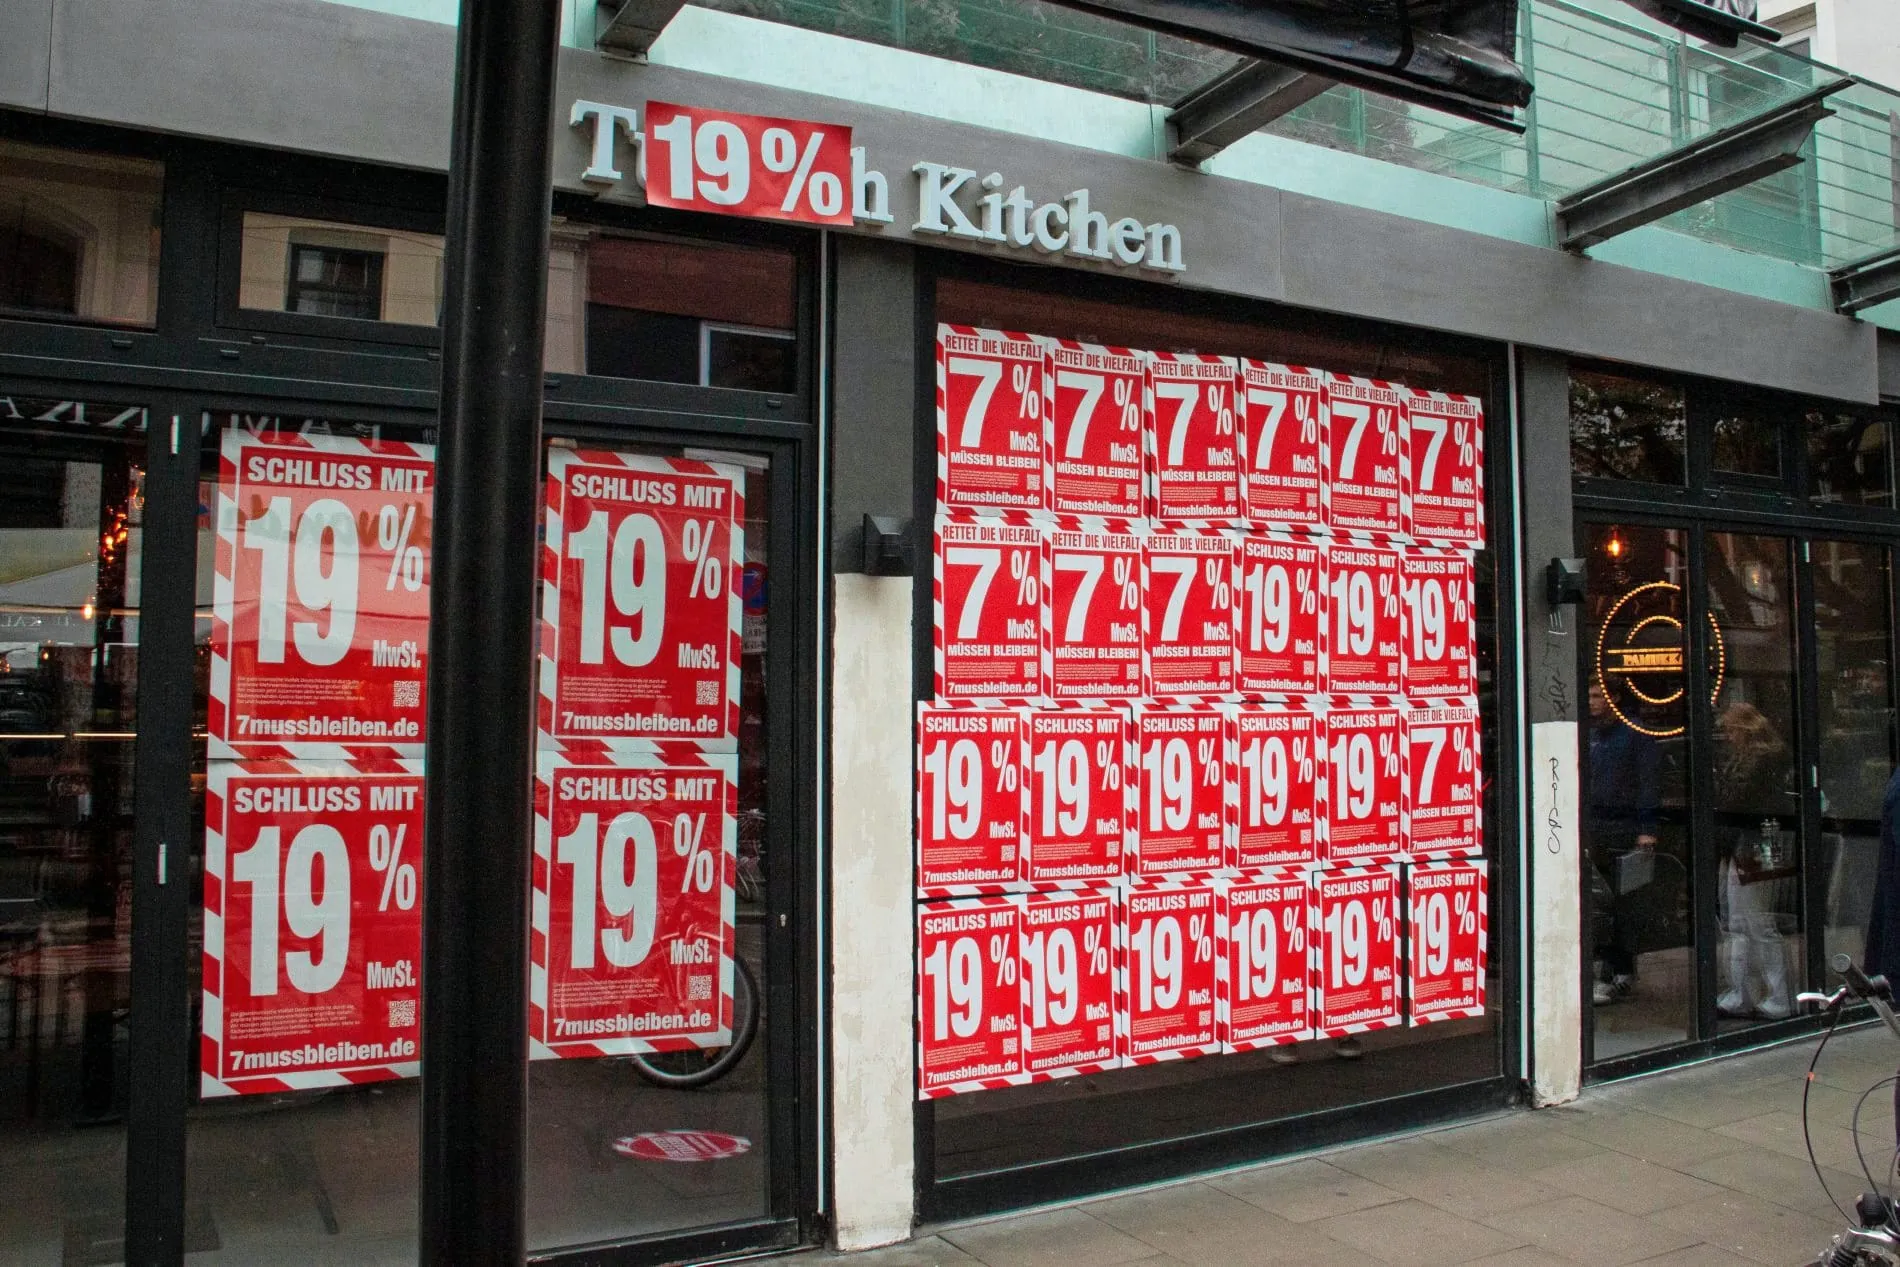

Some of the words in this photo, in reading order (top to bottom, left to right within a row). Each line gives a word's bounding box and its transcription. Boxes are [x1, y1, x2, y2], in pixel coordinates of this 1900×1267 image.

[912, 160, 1187, 273] Kitchen
[946, 335, 978, 351] RETTET
[982, 340, 997, 353] DIE
[1001, 342, 1042, 358] VIELFALT
[1053, 350, 1083, 366] RETTET
[1086, 354, 1100, 368] DIE
[1103, 356, 1142, 372] VIELFALT
[1151, 363, 1178, 377] RETTET
[1181, 364, 1193, 376] DIE
[1196, 365, 1232, 378] VIELFALT
[1010, 431, 1040, 452] MwSt.
[951, 450, 993, 465] MÜSSEN
[996, 456, 1040, 468] BLEIBEN!
[1111, 443, 1138, 463] MwSt.
[248, 456, 371, 491] SCHLUSS
[380, 468, 428, 494] MIT
[1057, 461, 1094, 476] MÜSSEN
[1098, 466, 1138, 479] BLEIBEN!
[1162, 469, 1194, 481] MÜSSEN
[1198, 472, 1235, 481] BLEIBEN!
[572, 474, 676, 505] SCHLUSS
[684, 485, 725, 508] MIT
[951, 489, 1040, 505] 7mussbleiben.de
[1057, 498, 1138, 514] 7mussbleiben.de
[1163, 505, 1237, 515] 7mussbleiben.de
[1250, 506, 1317, 520] 7mussbleiben.de
[1333, 514, 1397, 529] 7mussbleiben.de
[943, 525, 976, 540] RETTET
[981, 527, 995, 540] DIE
[999, 528, 1040, 542] VIELFALT
[1414, 525, 1474, 538] 7mussbleiben.de
[1052, 533, 1082, 547] RETTET
[1086, 534, 1098, 548] DIE
[1102, 536, 1140, 550] VIELFALT
[1147, 536, 1176, 550] RETTET
[1180, 538, 1192, 550] DIE
[1196, 538, 1231, 551] VIELFALT
[1247, 543, 1294, 560] SCHLUSS
[1297, 549, 1316, 562] MIT
[1332, 550, 1376, 566] SCHLUSS
[1379, 555, 1396, 568] MIT
[1404, 560, 1445, 573] SCHLUSS
[1448, 562, 1464, 573] MIT
[1008, 619, 1037, 639] MwSt.
[1111, 623, 1138, 642] MwSt.
[372, 639, 420, 668] MwSt.
[678, 643, 719, 669] MwSt.
[948, 642, 990, 656] MÜSSEN
[994, 645, 1037, 656] BLEIBEN!
[1056, 645, 1095, 658] MÜSSEN
[1098, 648, 1138, 658] BLEIBEN!
[1153, 644, 1189, 657] MÜSSEN
[1192, 646, 1230, 656] BLEIBEN!
[948, 682, 1037, 694] 7mussbleiben.de
[1056, 683, 1138, 694] 7mussbleiben.de
[1154, 680, 1230, 692] 7mussbleiben.de
[1243, 678, 1314, 690] 7mussbleiben.de
[1331, 680, 1398, 691] 7mussbleiben.de
[1409, 684, 1468, 695] 7mussbleiben.de
[236, 715, 418, 736] 7mussbleiben.de
[562, 712, 717, 732] 7mussbleiben.de
[926, 717, 987, 732] SCHLUSS
[992, 718, 1016, 732] MIT
[1035, 718, 1093, 733] SCHLUSS
[1097, 719, 1119, 732] MIT
[1144, 718, 1195, 732] SCHLUSS
[1199, 718, 1220, 731] MIT
[1242, 718, 1289, 731] SCHLUSS
[1292, 717, 1311, 730] MIT
[1330, 714, 1376, 728] SCHLUSS
[1379, 714, 1396, 726] MIT
[560, 777, 667, 800] SCHLUSS
[674, 778, 716, 800] MIT
[235, 787, 360, 812] SCHLUSS
[370, 786, 418, 810] MIT
[990, 822, 1016, 838] MwSt.
[1097, 818, 1120, 834] MwSt.
[1332, 841, 1398, 856] 7mussbleiben.de
[1412, 836, 1473, 850] 7mussbleiben.de
[1142, 856, 1220, 870] 7mussbleiben.de
[1242, 849, 1311, 864] 7mussbleiben.de
[924, 868, 1014, 882] 7mussbleiben.de
[1034, 863, 1118, 877] 7mussbleiben.de
[1324, 880, 1369, 898] SCHLUSS
[1372, 878, 1390, 891] MIT
[1414, 874, 1452, 890] SCHLUSS
[1455, 873, 1475, 885] MIT
[1132, 895, 1186, 912] SCHLUSS
[1190, 893, 1210, 908] MIT
[1231, 888, 1280, 905] SCHLUSS
[1284, 886, 1303, 900] MIT
[1084, 903, 1106, 918] MIT
[925, 914, 986, 934] SCHLUSS
[991, 911, 1014, 927] MIT
[671, 938, 712, 964] MwSt.
[368, 960, 416, 989] MwSt.
[1086, 1003, 1109, 1020] MwSt.
[1416, 996, 1474, 1012] 7mussbleiben.de
[554, 1010, 711, 1036] 7mussbleiben.de
[991, 1014, 1016, 1032] MwSt.
[1326, 1005, 1392, 1025] 7mussbleiben.de
[1233, 1019, 1303, 1039] 7mussbleiben.de
[1133, 1031, 1210, 1052] 7mussbleiben.de
[230, 1038, 415, 1070] 7mussbleiben.de
[1032, 1046, 1110, 1070] mussbleiben.de
[927, 1060, 1018, 1084] 7mussbleiben.de
